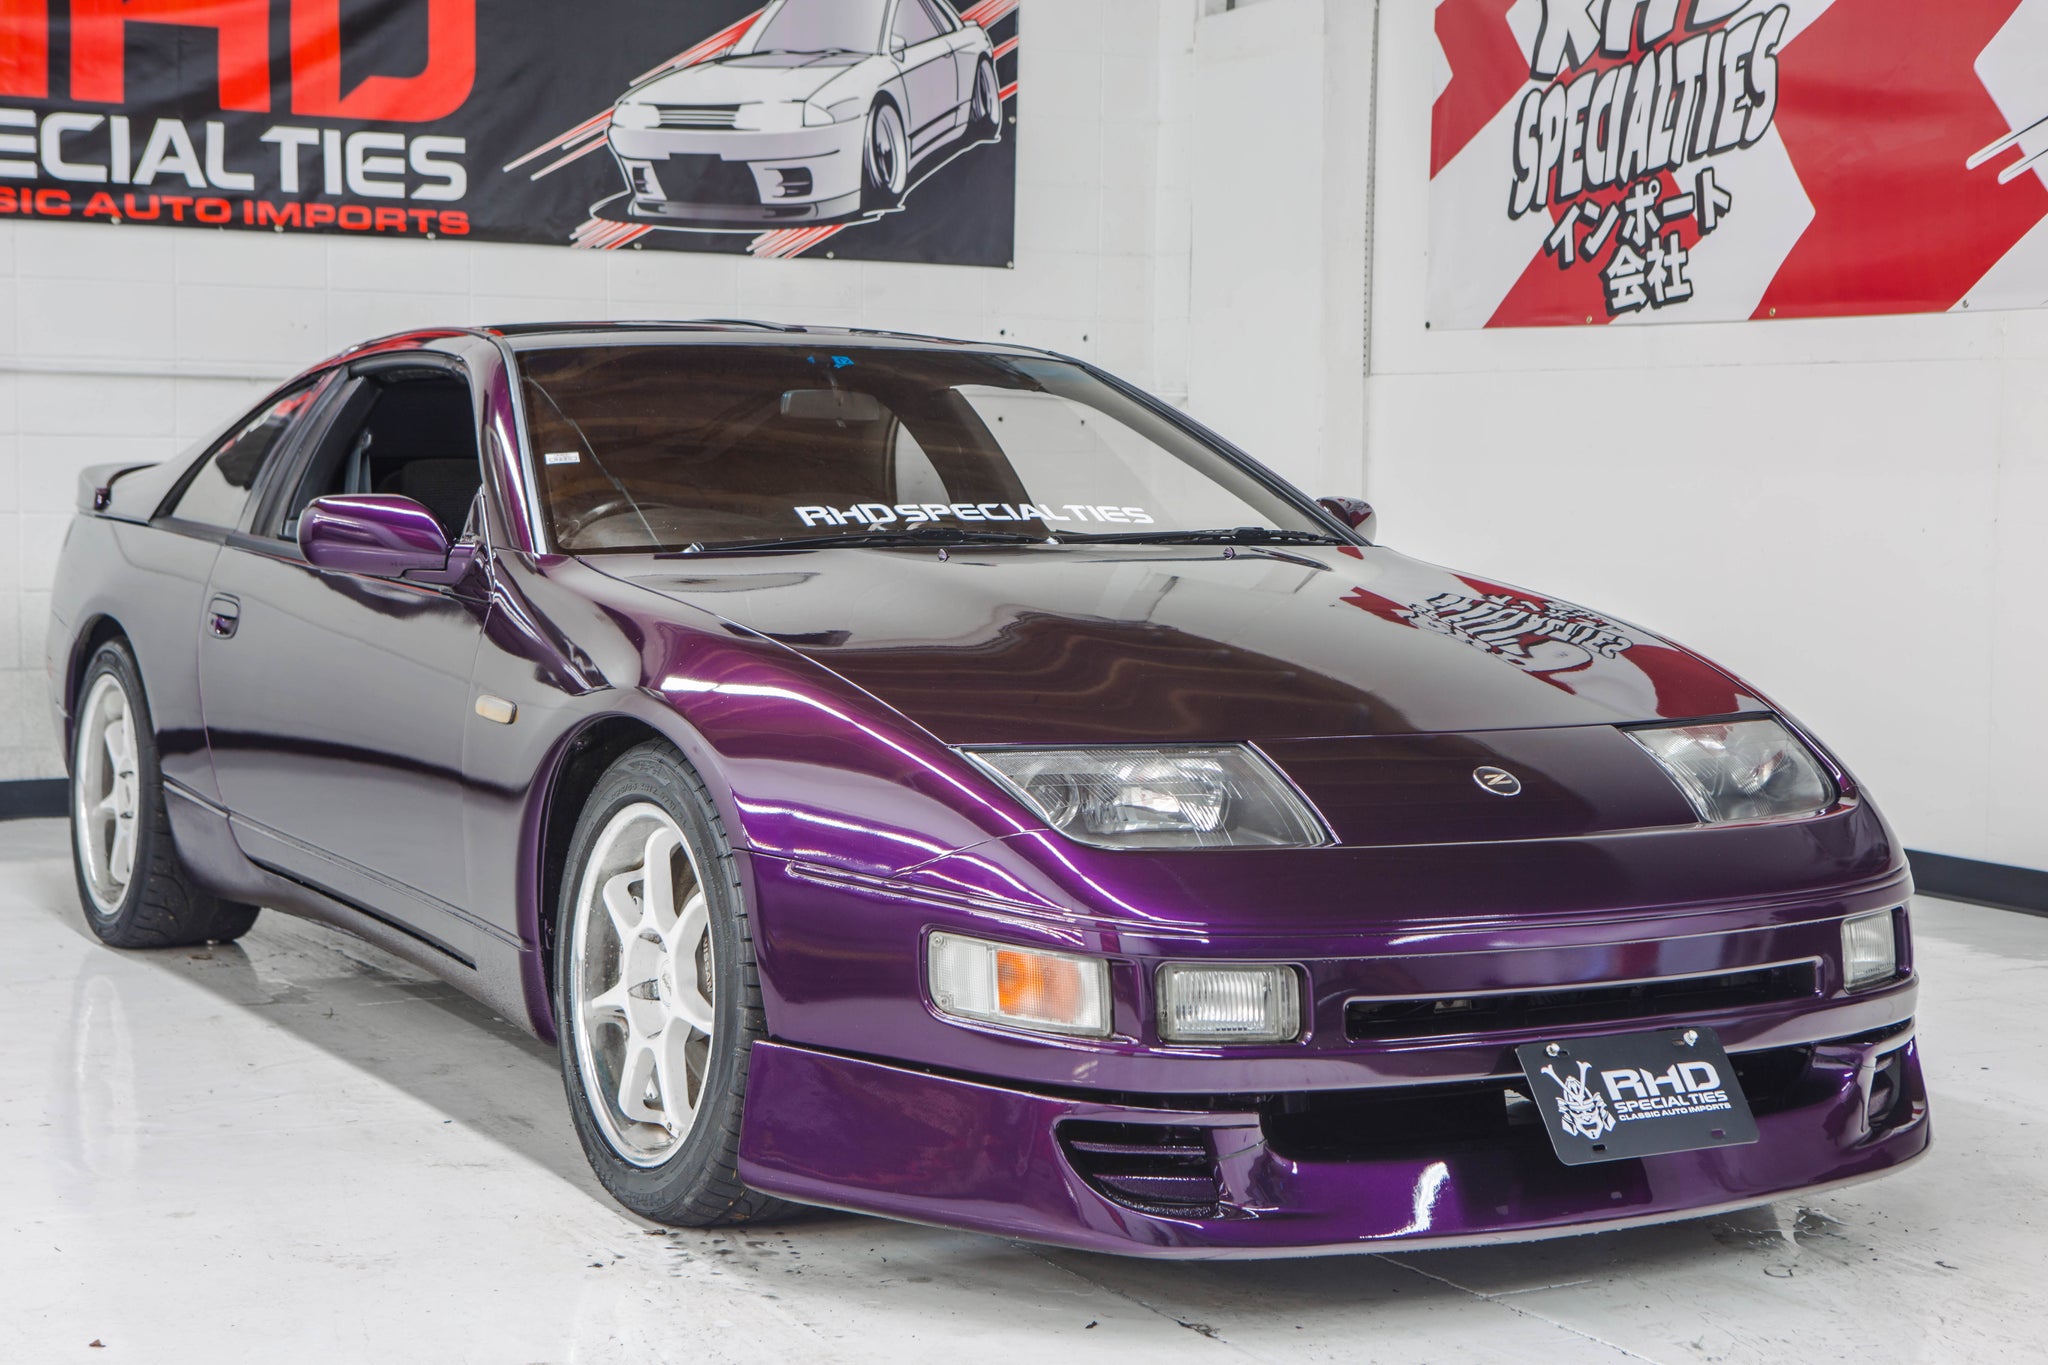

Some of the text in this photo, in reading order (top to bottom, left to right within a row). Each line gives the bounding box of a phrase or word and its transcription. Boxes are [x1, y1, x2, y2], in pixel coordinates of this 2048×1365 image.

[0, 0, 477, 123] HD
[1507, 4, 1790, 220] SPECIALTIES
[83, 191, 232, 224] AUTO
[243, 201, 471, 236] IMPORTS
[1544, 167, 1732, 270] インポート
[1599, 231, 1694, 315] 会社
[1601, 1061, 1721, 1100] RHD
[1614, 1090, 1729, 1114] SPECIALTIES
[1619, 1102, 1731, 1121] CLASSIC AUTO IMPORTS
